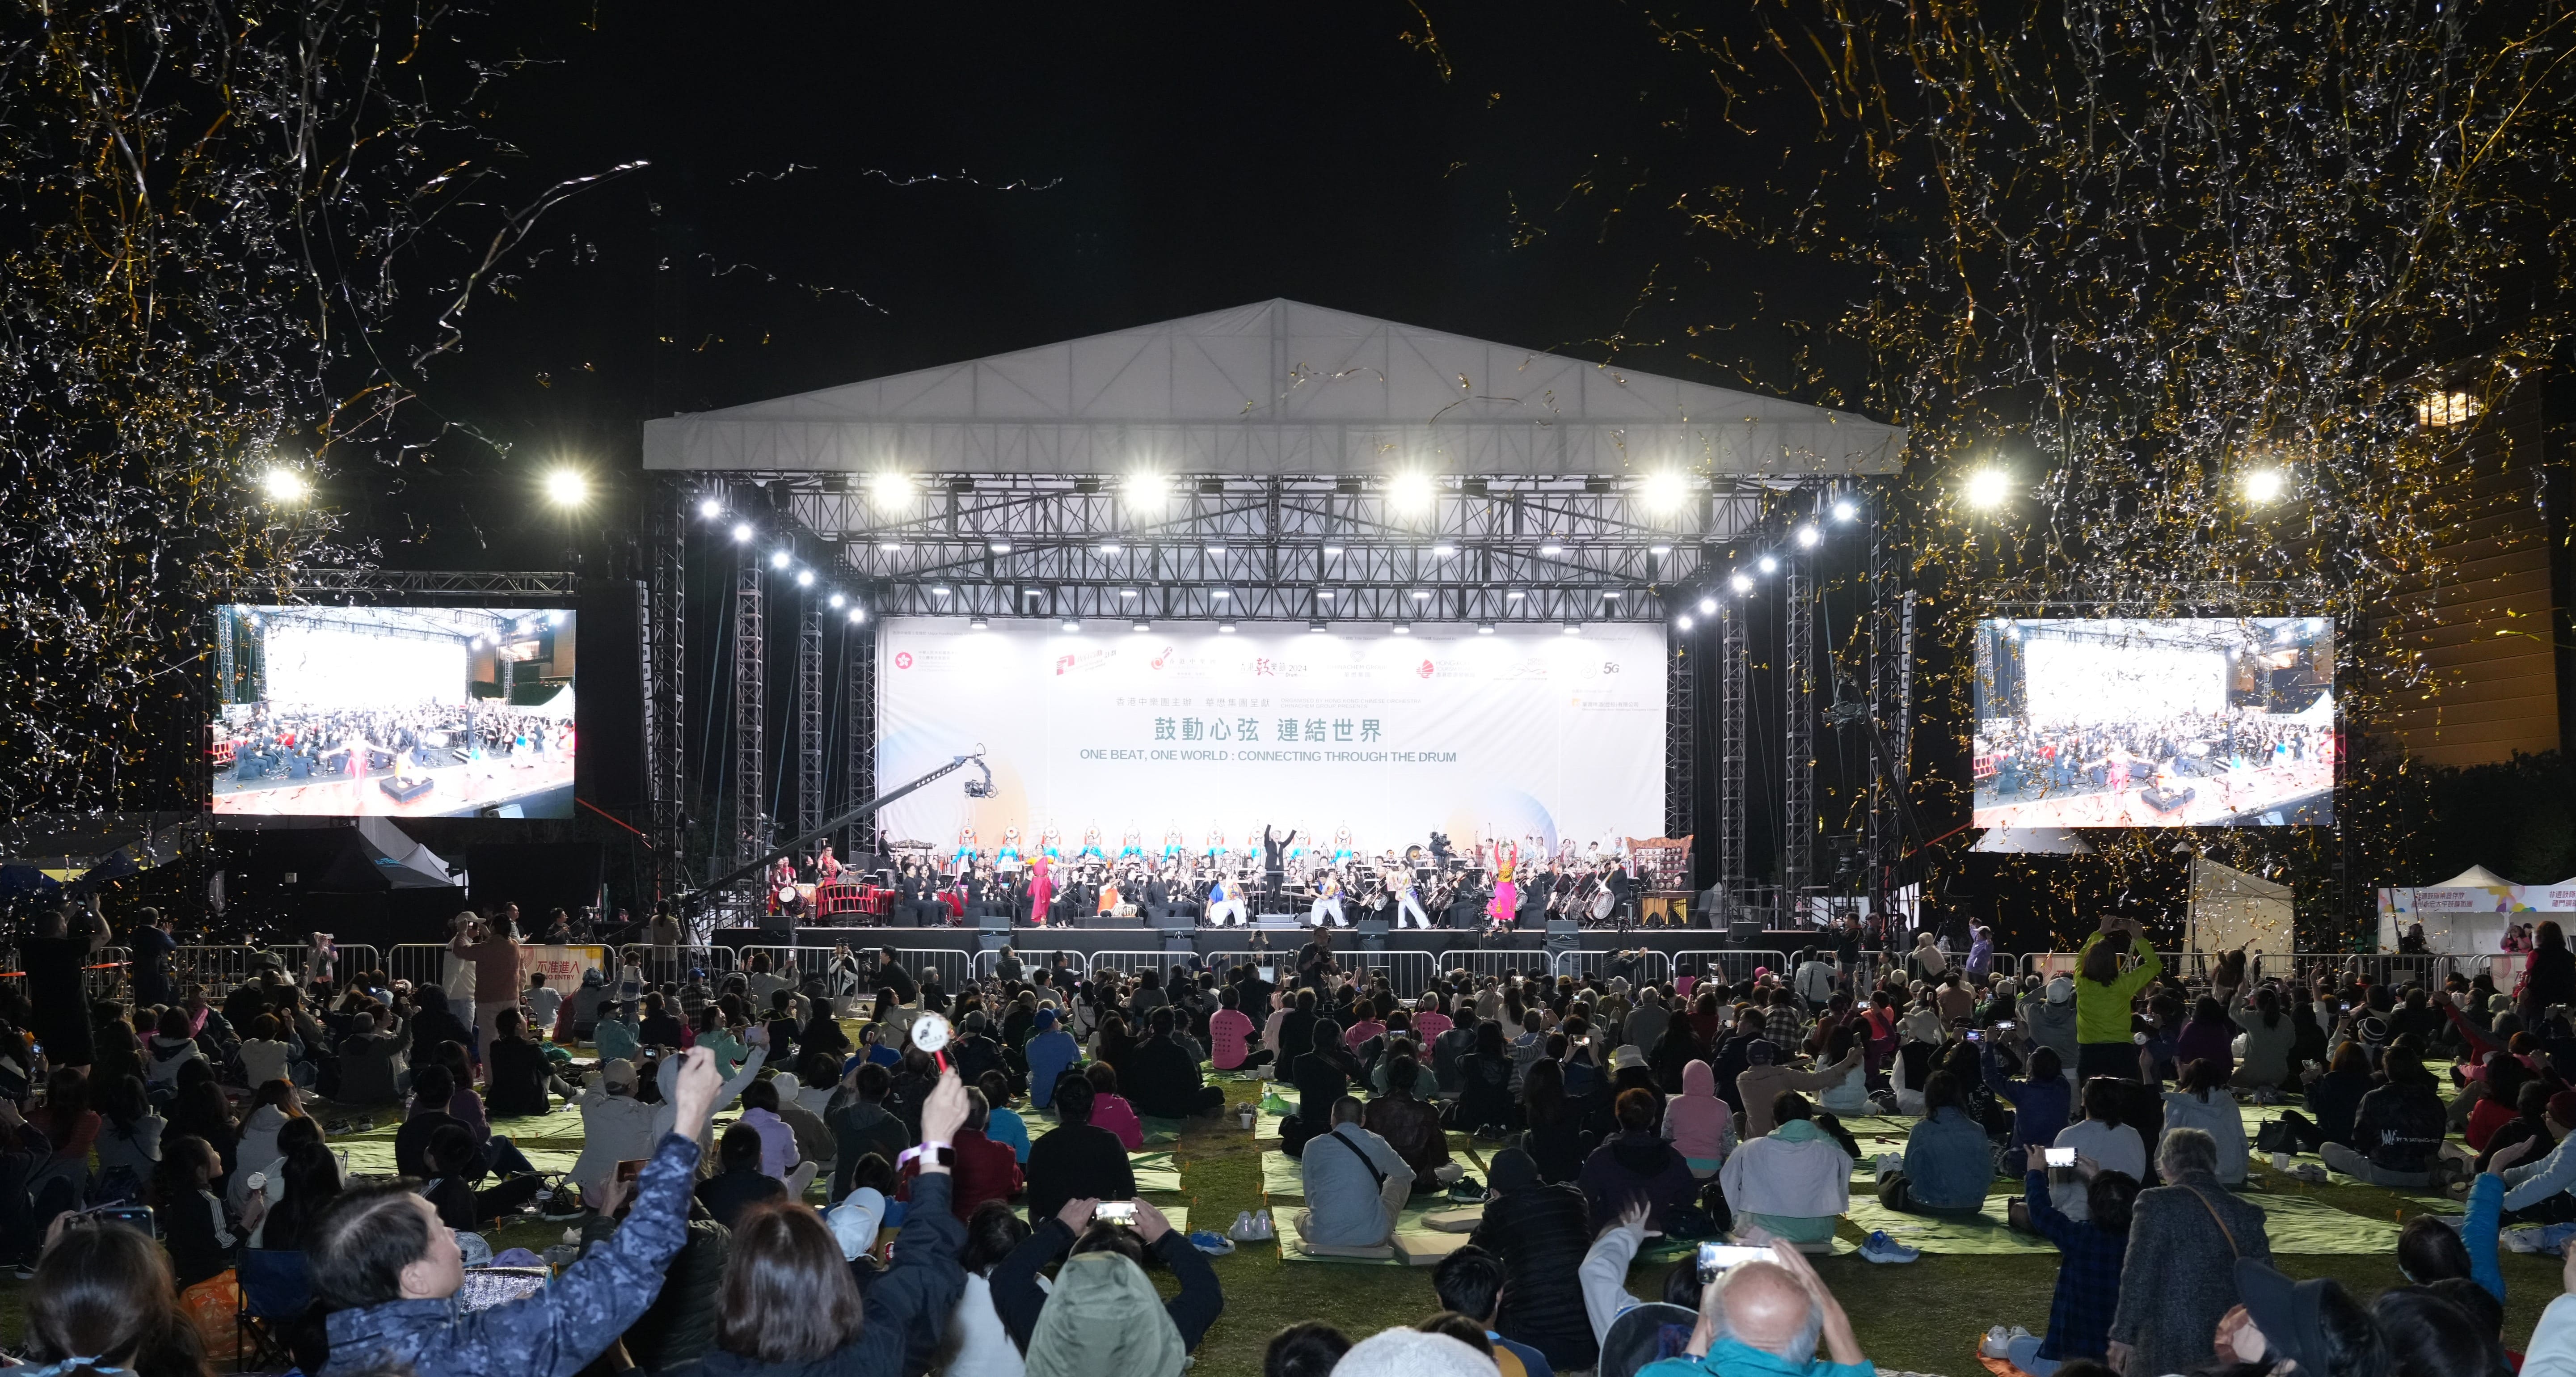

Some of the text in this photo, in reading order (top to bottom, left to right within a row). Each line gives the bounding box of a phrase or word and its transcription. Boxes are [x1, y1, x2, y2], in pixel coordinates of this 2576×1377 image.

[1603, 662, 1620, 674] 5G
[1116, 697, 1270, 707] 香港中樂團主辦 華懋集團呈獻
[1155, 717, 1381, 743] 鼓動心弦 連結世界
[1080, 749, 1107, 760] ONE
[1111, 749, 1147, 762] BEAT,
[1151, 750, 1178, 760] ONE
[1180, 750, 1228, 760] WORLD
[1238, 751, 1321, 761] CONNECTING
[1324, 751, 1386, 762] THROUGH
[1390, 752, 1416, 762] THE
[1419, 752, 1457, 762] DRUM
[536, 961, 580, 974] 不准進入
